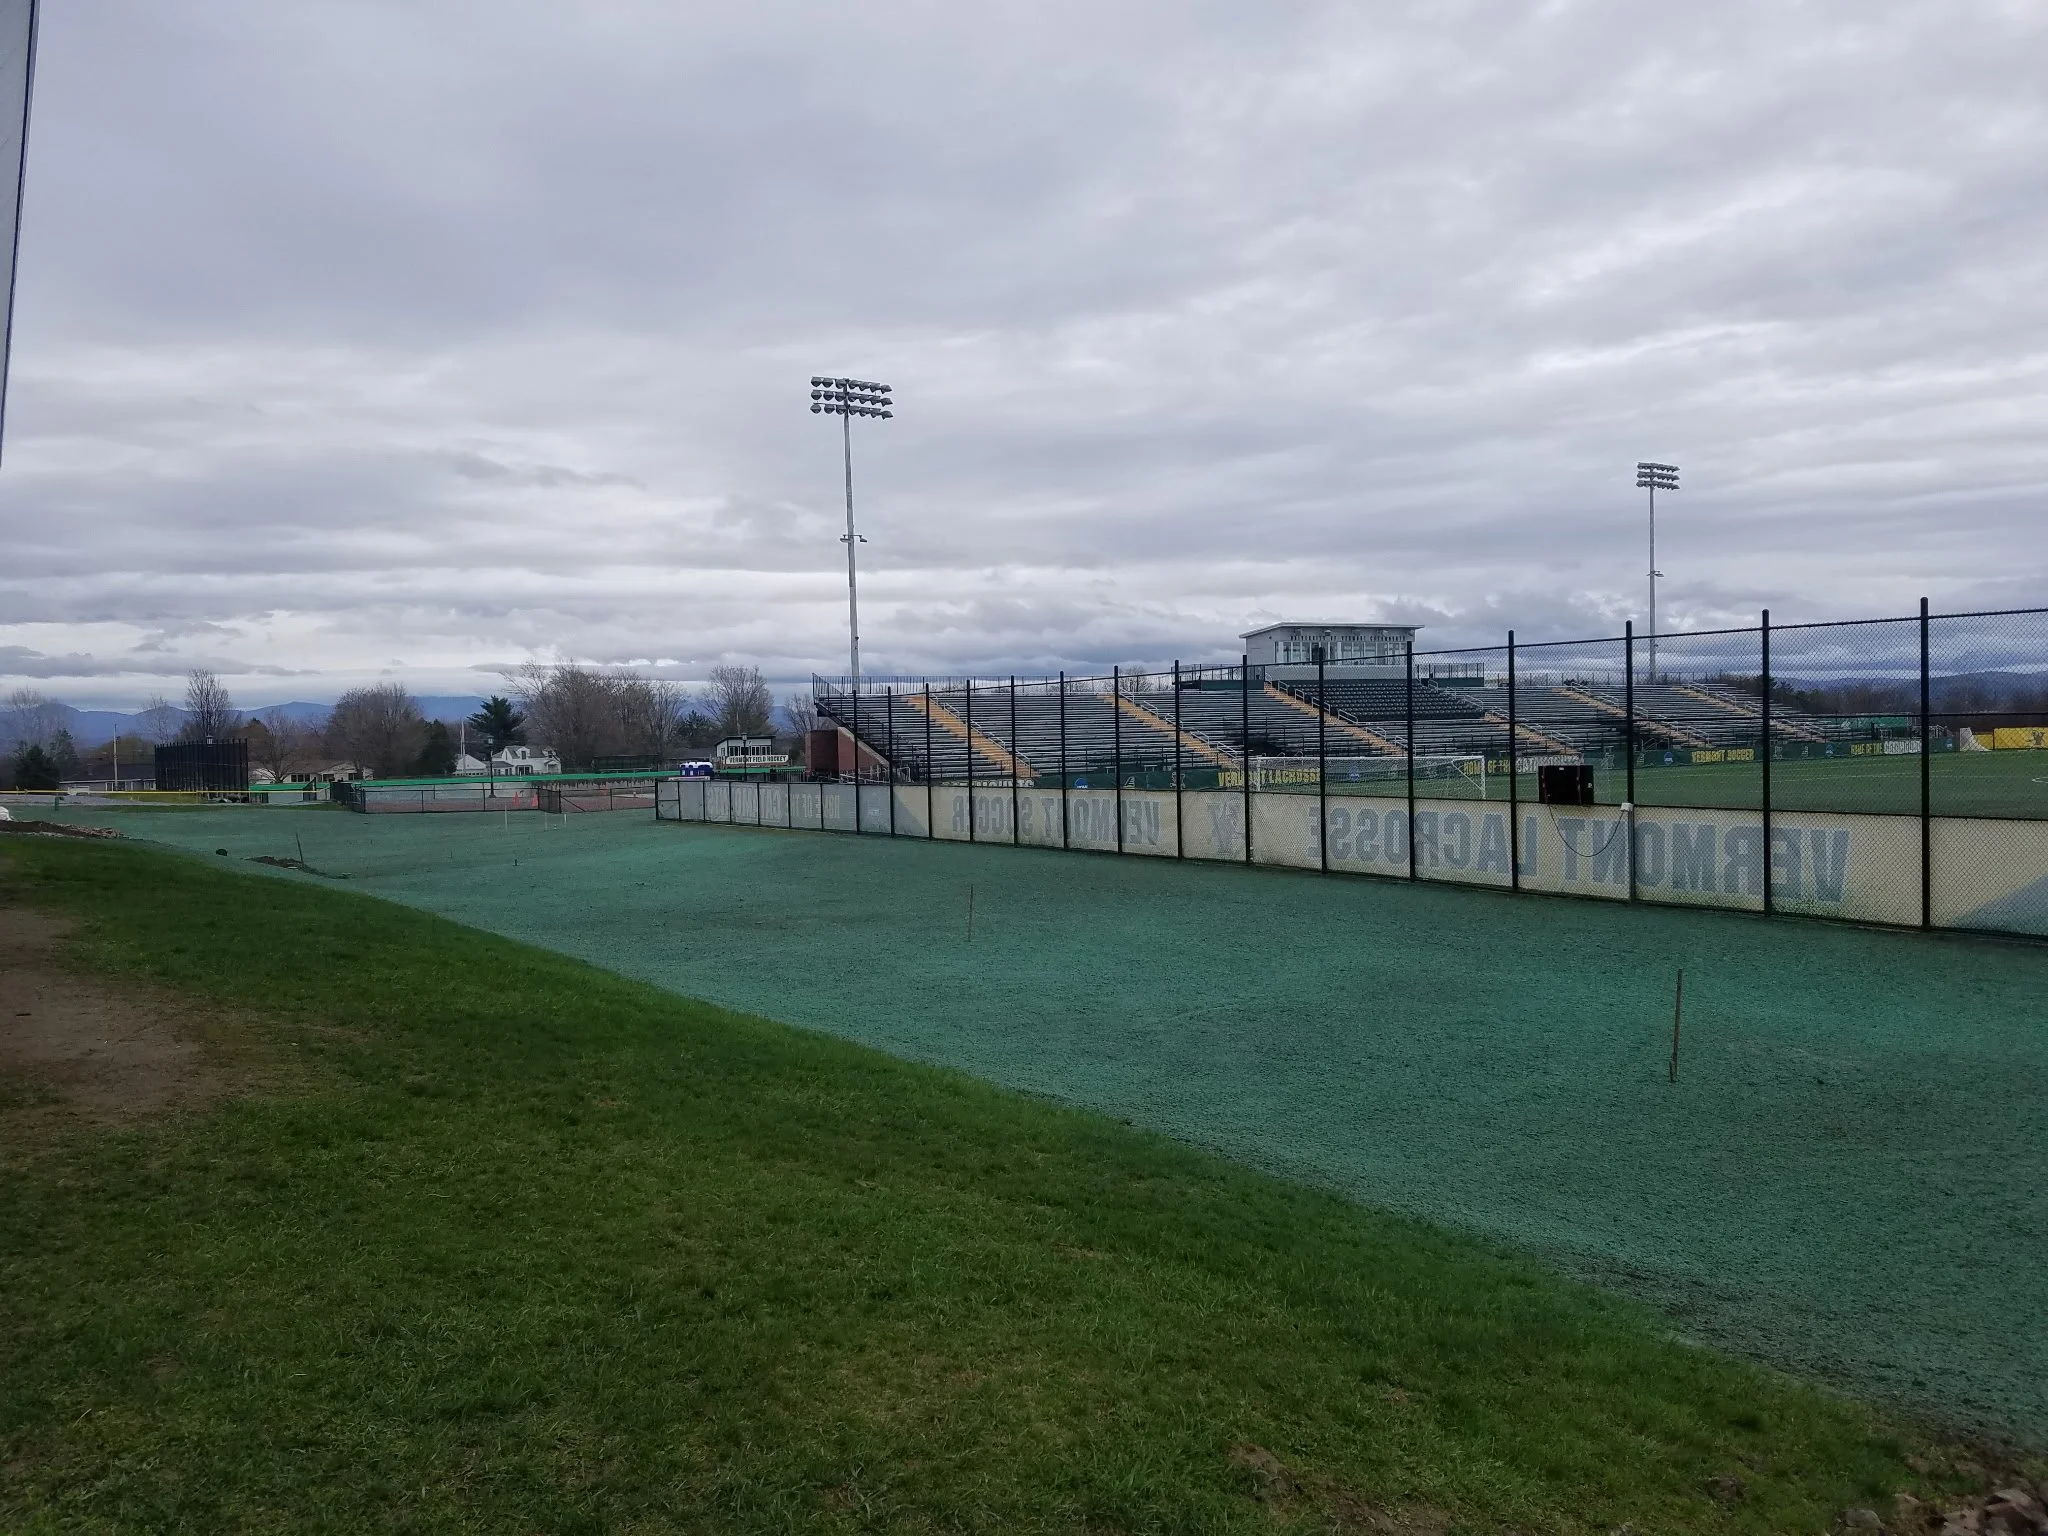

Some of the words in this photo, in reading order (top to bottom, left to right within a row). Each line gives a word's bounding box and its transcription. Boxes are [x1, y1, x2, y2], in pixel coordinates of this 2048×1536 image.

[752, 755, 766, 763] FIELD
[1691, 750, 1725, 762] VERMONT
[1727, 748, 1755, 760] SOCCER
[1463, 760, 1481, 774] HOM
[1218, 770, 1267, 787] VERMNT
